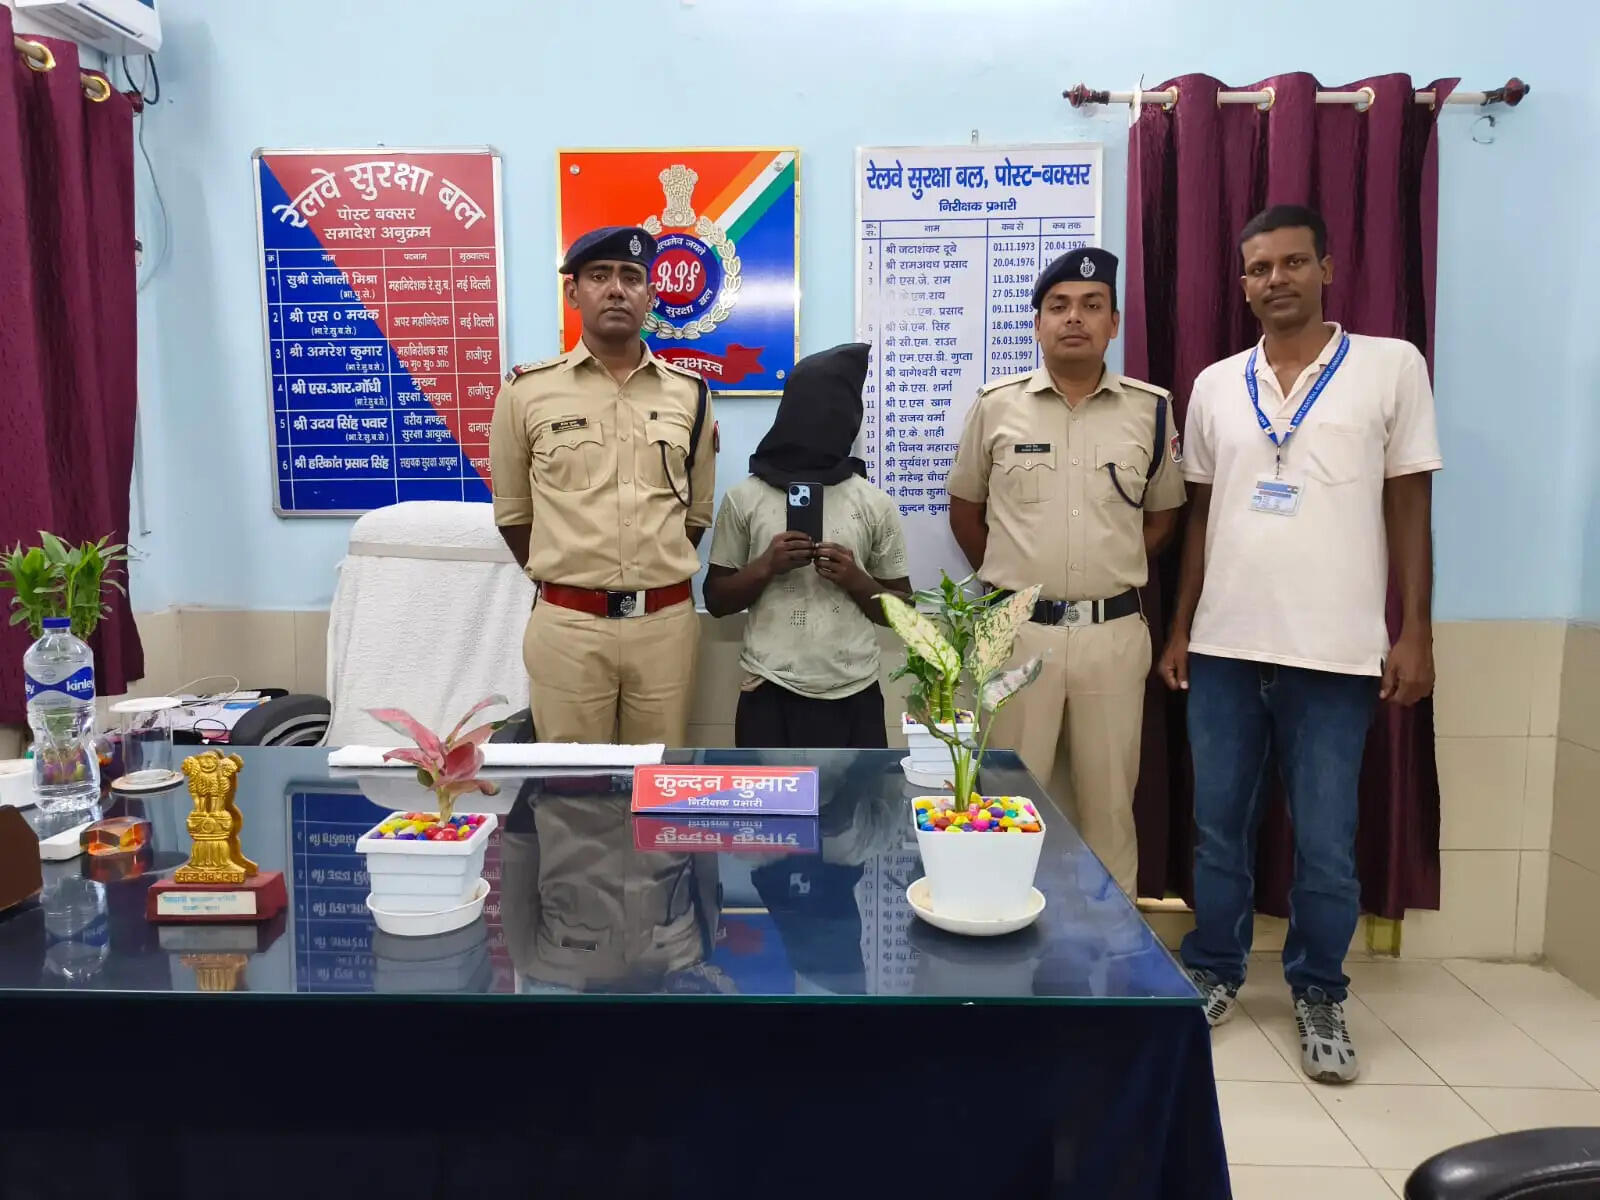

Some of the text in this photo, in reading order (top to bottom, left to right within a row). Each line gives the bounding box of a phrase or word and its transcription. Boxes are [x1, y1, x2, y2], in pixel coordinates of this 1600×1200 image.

[866, 157, 1092, 200] रेलवे सुरक्षा बल, पोस्ट-बक्सर
[272, 161, 486, 229] रेलवे सुरक्षा बल
[939, 198, 1017, 212] निरीक्षक प्रभारी
[337, 205, 416, 222] पोस्ट बक्सर
[924, 224, 940, 233] नाम
[1001, 221, 1024, 232] कब से
[1052, 222, 1082, 230] कब तक
[323, 223, 432, 243] समादेश अनुक्रम
[868, 246, 873, 254] 1
[886, 242, 896, 254] श्री
[943, 242, 958, 256] दूबे
[993, 242, 1036, 252] 01.11.1973
[868, 262, 873, 270] 2
[886, 258, 969, 270] श्री रामअवध प्रसाद
[993, 258, 1036, 267] 20.04.1976
[272, 276, 276, 286] 1
[286, 272, 378, 288] सुश्री सोनाली मिश्रा
[456, 275, 492, 292] नई दिल्ली
[886, 274, 896, 286] श्री
[934, 276, 952, 284] राम
[993, 274, 1034, 284] 11.03.1981
[665, 288, 713, 318] सुरक्षा बल
[992, 304, 1034, 313] 09.11.1985
[289, 306, 380, 324] श्री एस मयंक
[939, 306, 964, 316] प्रसाद
[273, 312, 278, 323] 2
[394, 316, 410, 327] अपर
[460, 312, 495, 330] नई दिल्ली
[932, 320, 951, 331] सिंह
[992, 320, 1034, 330] 18.06.1990
[886, 336, 896, 347] श्री
[934, 338, 957, 346] राउत
[992, 336, 1033, 345] 26.03.1995
[275, 349, 280, 359] 3
[290, 342, 384, 360] श्री अमरेश कुमार
[465, 347, 493, 365] हाजीपुर
[992, 351, 1032, 360] 02.05.1997
[886, 351, 896, 362] श्री
[951, 352, 973, 365] गुप्ता
[672, 357, 724, 376] लभस्व
[886, 366, 962, 378] श्री बागेश्वरी चरण
[868, 370, 873, 378] 9
[291, 378, 306, 395] श्री
[410, 378, 438, 390] मुख्य
[866, 385, 876, 394] 10
[885, 382, 896, 393] श्री
[933, 380, 952, 392] शर्मा
[466, 382, 495, 400] हाजीपुर
[397, 392, 452, 406] सुरक्षा आयुक्त
[866, 400, 875, 409] 11
[885, 396, 896, 408] श्री
[931, 398, 952, 408] खान
[293, 414, 388, 431] श्री उदय सिंह पवार
[403, 412, 447, 426] वरीय मण्डल
[866, 416, 876, 424] 12
[885, 412, 896, 423] श्री
[927, 410, 946, 422] वर्मा
[280, 418, 286, 429] 5
[402, 429, 452, 442] सुरक्षा आयुक्त
[866, 430, 876, 439] 13
[885, 426, 896, 438] श्री
[924, 426, 944, 438] शाही
[866, 446, 875, 454] 14
[885, 442, 923, 453] श्री विनय
[282, 460, 288, 470] 6
[294, 454, 390, 470] श्री हरिकांत प्रसाद सिंह
[470, 458, 492, 472] दानापु
[866, 460, 875, 469] 15
[885, 457, 896, 468] श्री
[933, 458, 953, 468] प्रसा
[885, 471, 924, 483] श्री महेन्द्र
[899, 486, 923, 496] दीपक
[926, 488, 950, 500] कुमा
[899, 504, 925, 516] कुन्दन
[653, 774, 800, 798] कुन्दन कुमार
[732, 796, 763, 808] प्रभारी
